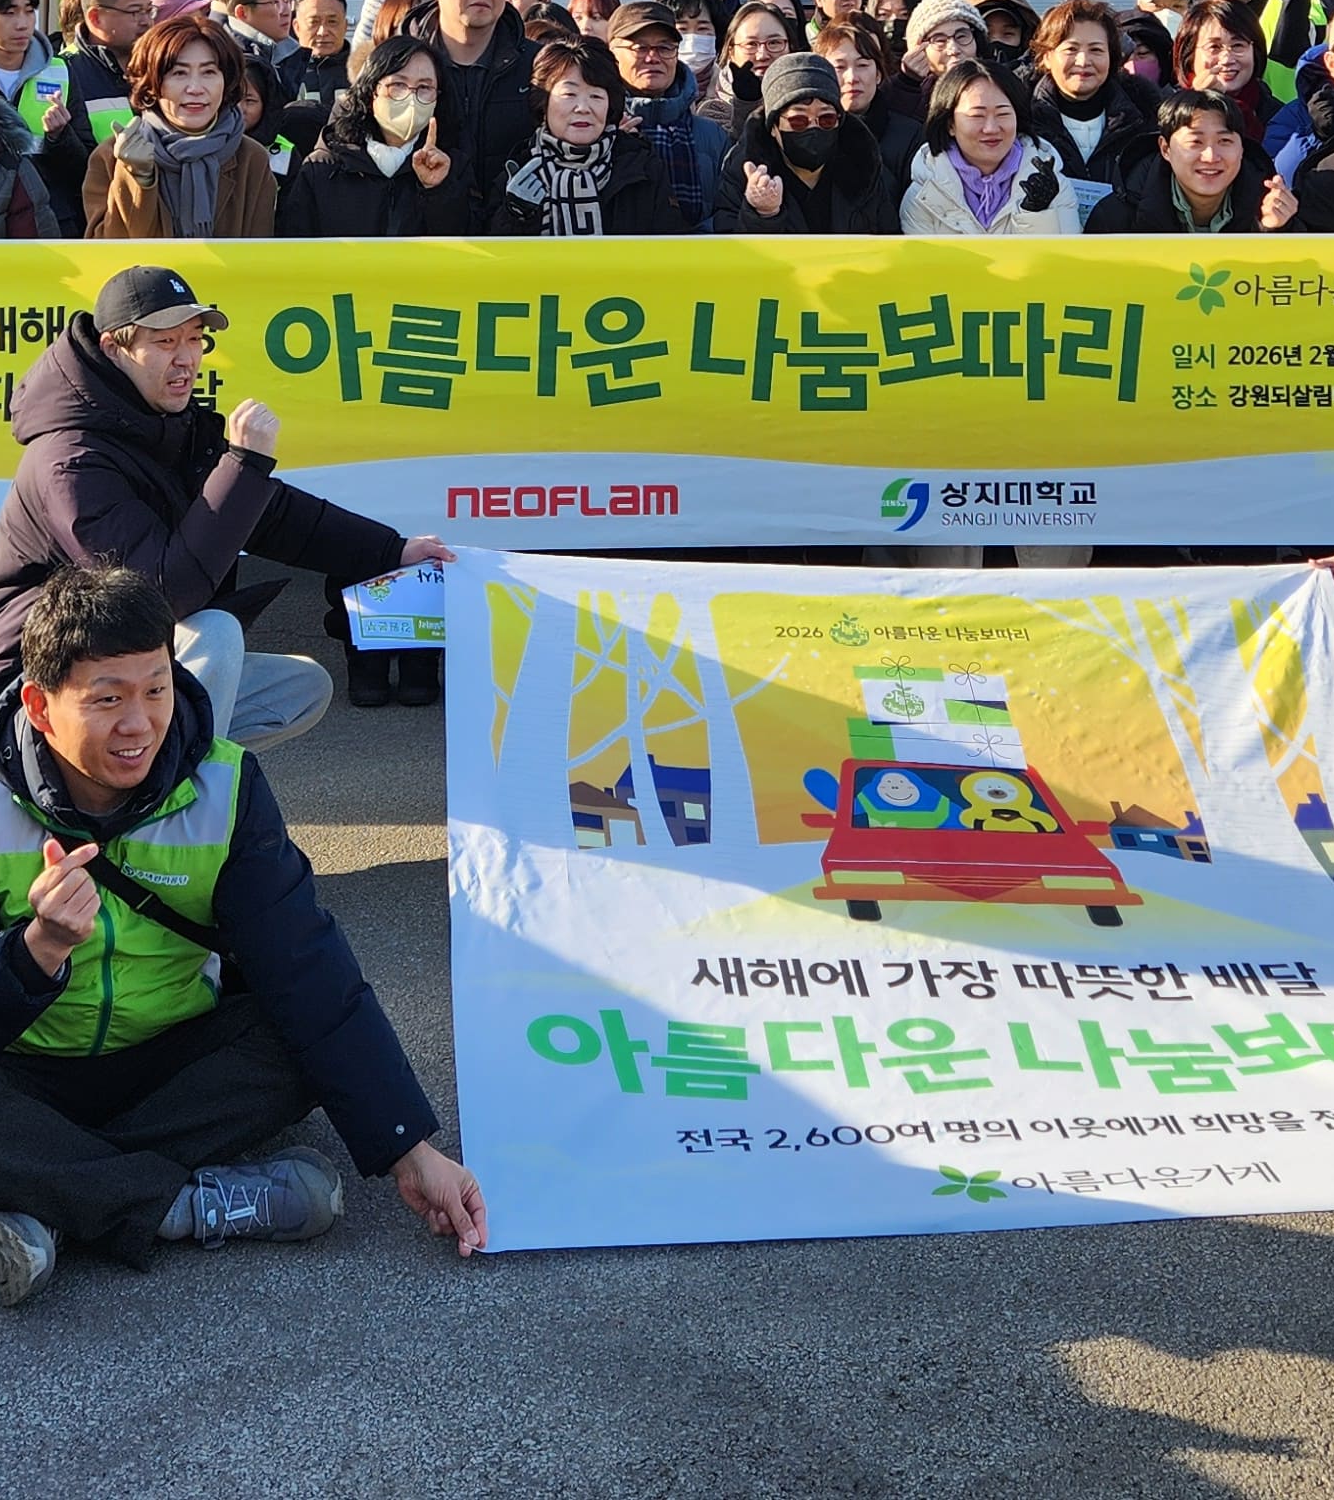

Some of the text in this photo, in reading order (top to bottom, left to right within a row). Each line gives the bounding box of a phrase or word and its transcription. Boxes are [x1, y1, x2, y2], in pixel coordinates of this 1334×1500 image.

[264, 292, 669, 411] 아름다운
[690, 293, 1145, 411] 나눔보따리
[1172, 344, 1216, 369] 일시
[1228, 344, 1303, 367] 2026년
[1172, 384, 1218, 410] 장소
[940, 481, 1098, 507] 상지대학교
[941, 512, 1097, 527] SANGJI UNIVERSITY
[774, 625, 824, 639] 2026
[873, 625, 942, 642] 아름다운
[945, 626, 1031, 642] 나눔보따리
[691, 957, 1327, 1002] 새해에 가장 따뜻한 배달
[525, 1008, 992, 1101] 아름다운
[676, 1127, 754, 1153] 전국
[763, 1119, 936, 1152] 2,600여
[943, 1118, 1023, 1144] 명의
[1029, 1114, 1186, 1139] 이웃에게
[1189, 1109, 1306, 1135] 희망을
[1011, 1160, 1282, 1195] 아름다운가게
